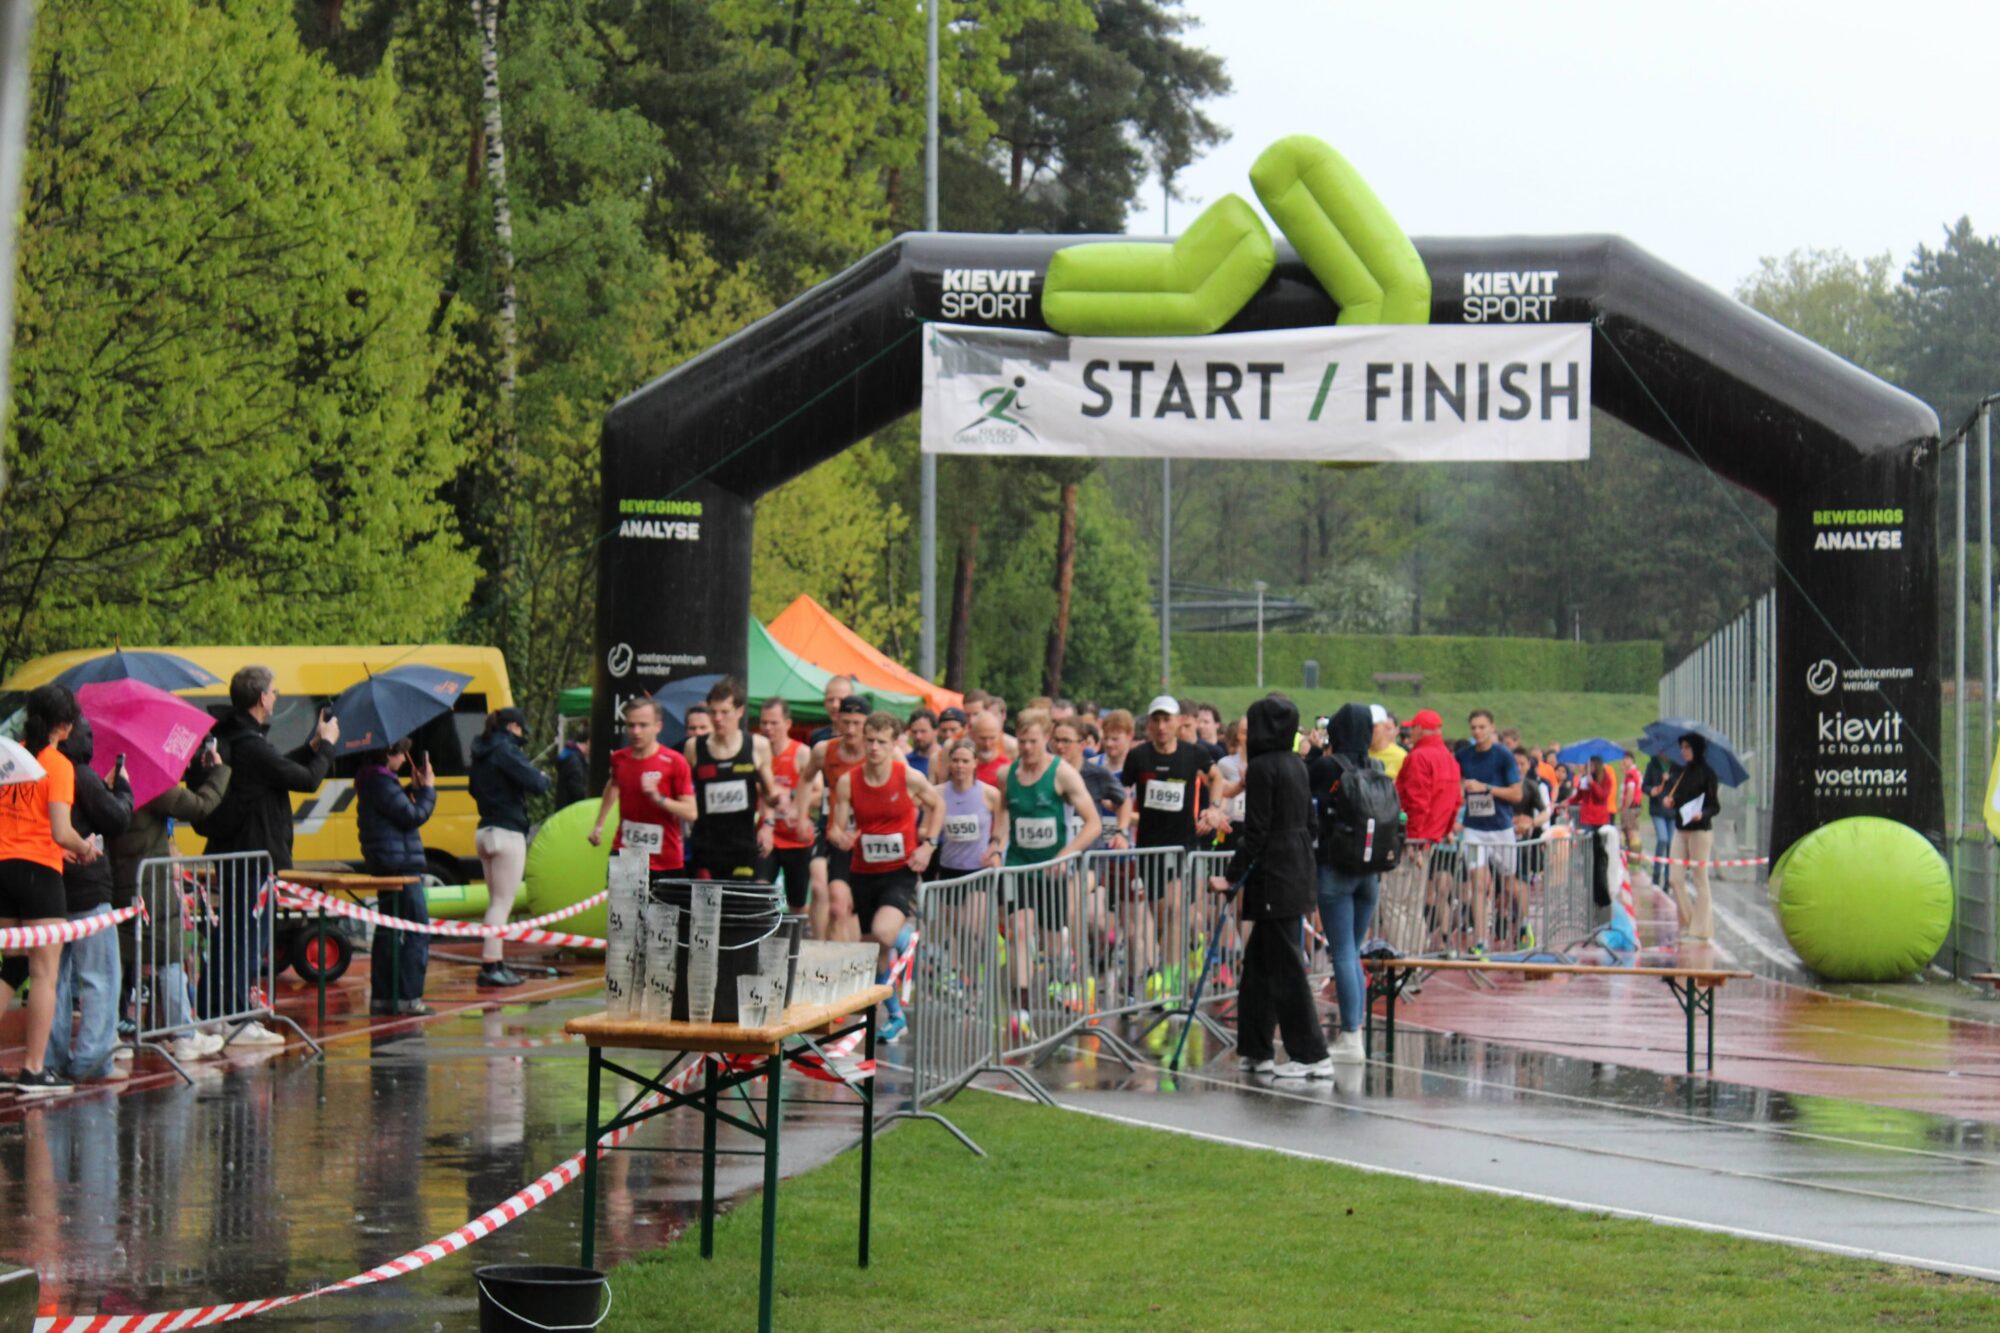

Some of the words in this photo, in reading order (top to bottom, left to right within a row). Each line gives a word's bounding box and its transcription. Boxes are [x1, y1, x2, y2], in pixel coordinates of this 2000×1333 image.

[942, 269, 1035, 292] KIEVIT
[1463, 271, 1558, 295] KIEVIT
[941, 292, 1032, 318] SPORT
[1463, 295, 1556, 322] SPORT
[1081, 359, 1284, 419] START
[1308, 363, 1339, 421] /
[1366, 361, 1578, 422] FINISH
[619, 500, 702, 516] BEWEGINGS
[1813, 509, 1903, 525] BEWEGINGS
[619, 520, 700, 540] ANALYSE
[1814, 530, 1902, 550] ANALYSE
[637, 653, 707, 665] voetencentrum
[637, 665, 670, 675] wender
[1842, 667, 1914, 679] voetencentrum
[1842, 680, 1880, 691] wender
[1819, 711, 1902, 741] kievit
[1820, 742, 1902, 754] schoenen
[1815, 767, 1907, 785] voetmax
[1149, 788, 1181, 803] 1899
[1814, 788, 1907, 796] ORTHOPEDIE
[946, 823, 976, 834] 1550
[1019, 827, 1053, 839] 1540
[866, 843, 900, 854] 1714
